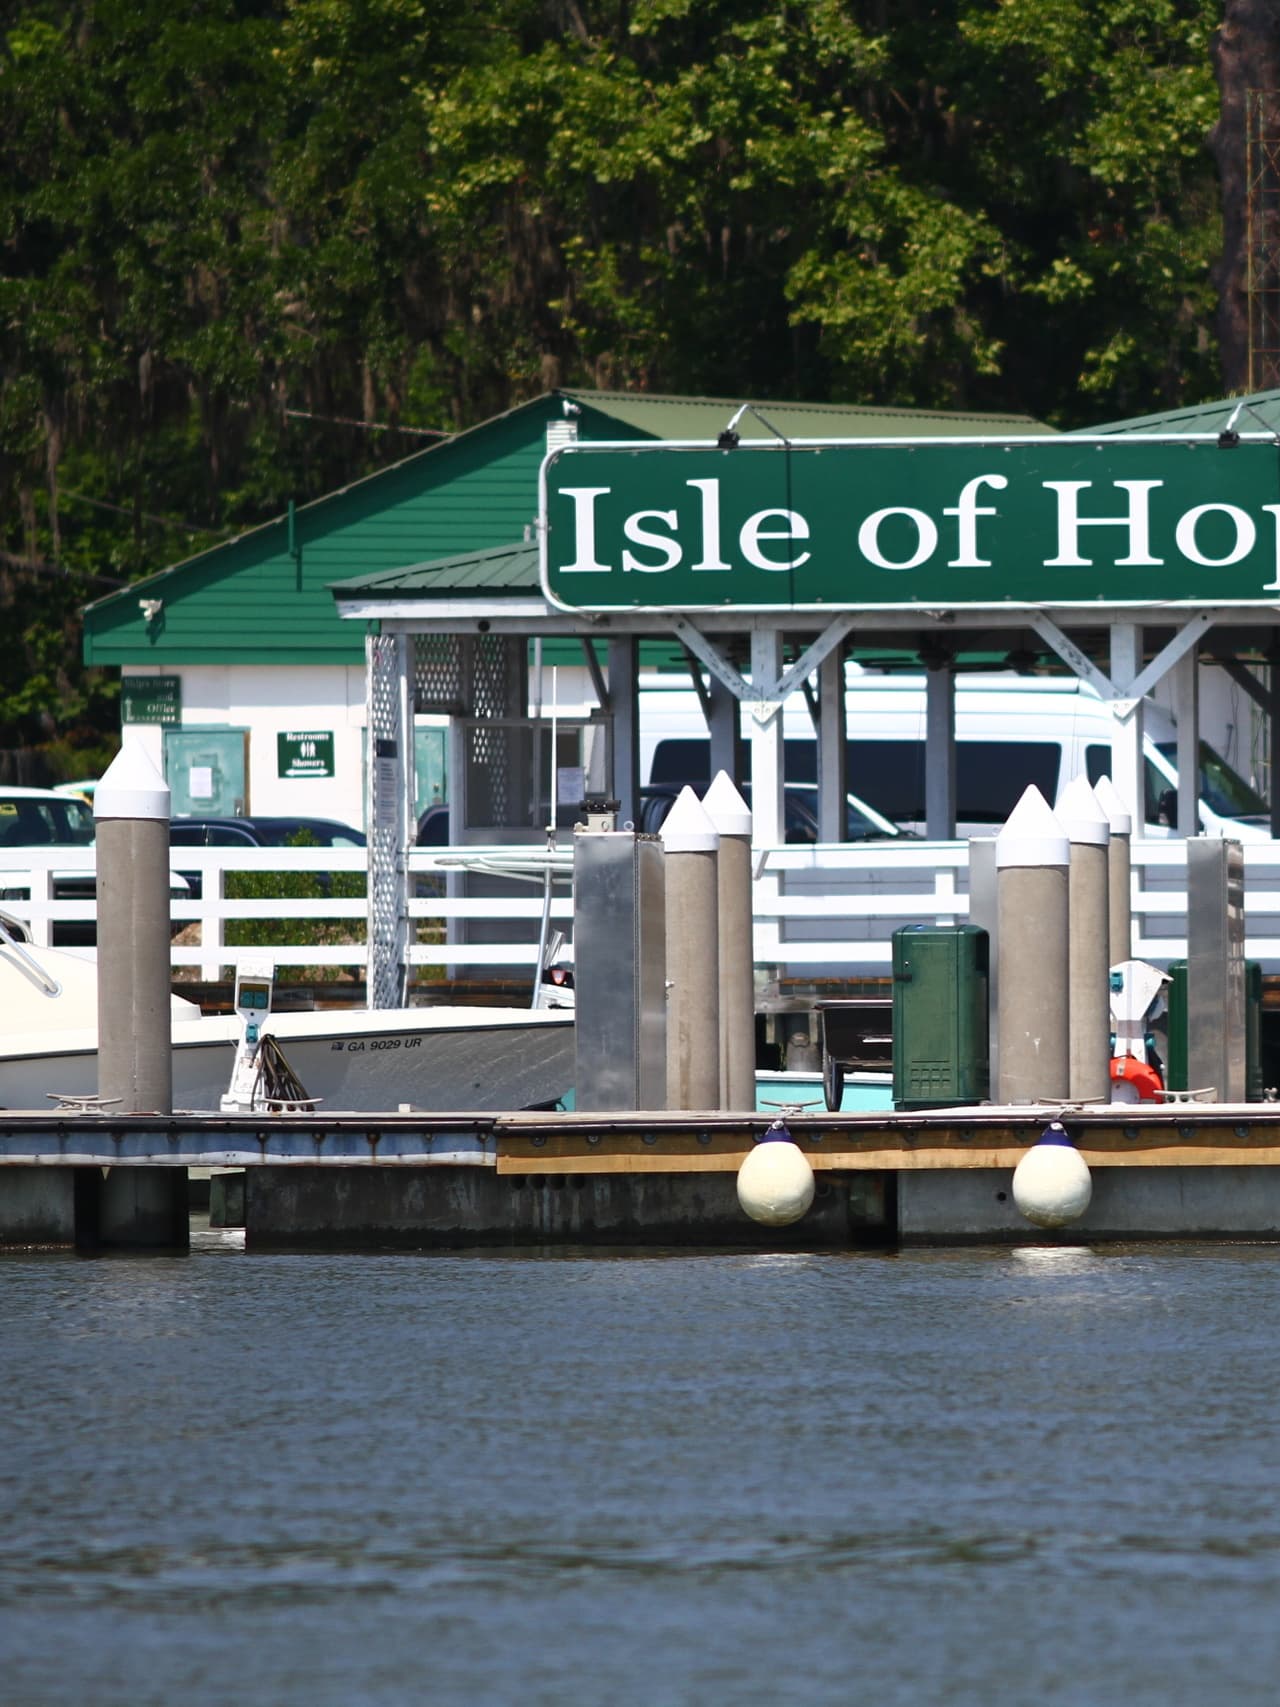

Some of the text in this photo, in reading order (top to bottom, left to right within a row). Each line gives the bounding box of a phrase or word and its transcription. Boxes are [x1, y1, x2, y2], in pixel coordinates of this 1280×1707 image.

[558, 478, 811, 573] Isle
[858, 474, 1008, 570] of
[286, 732, 329, 741] Restrooms
[291, 758, 325, 767] Showers
[347, 1038, 422, 1052] GA 9029 UR
